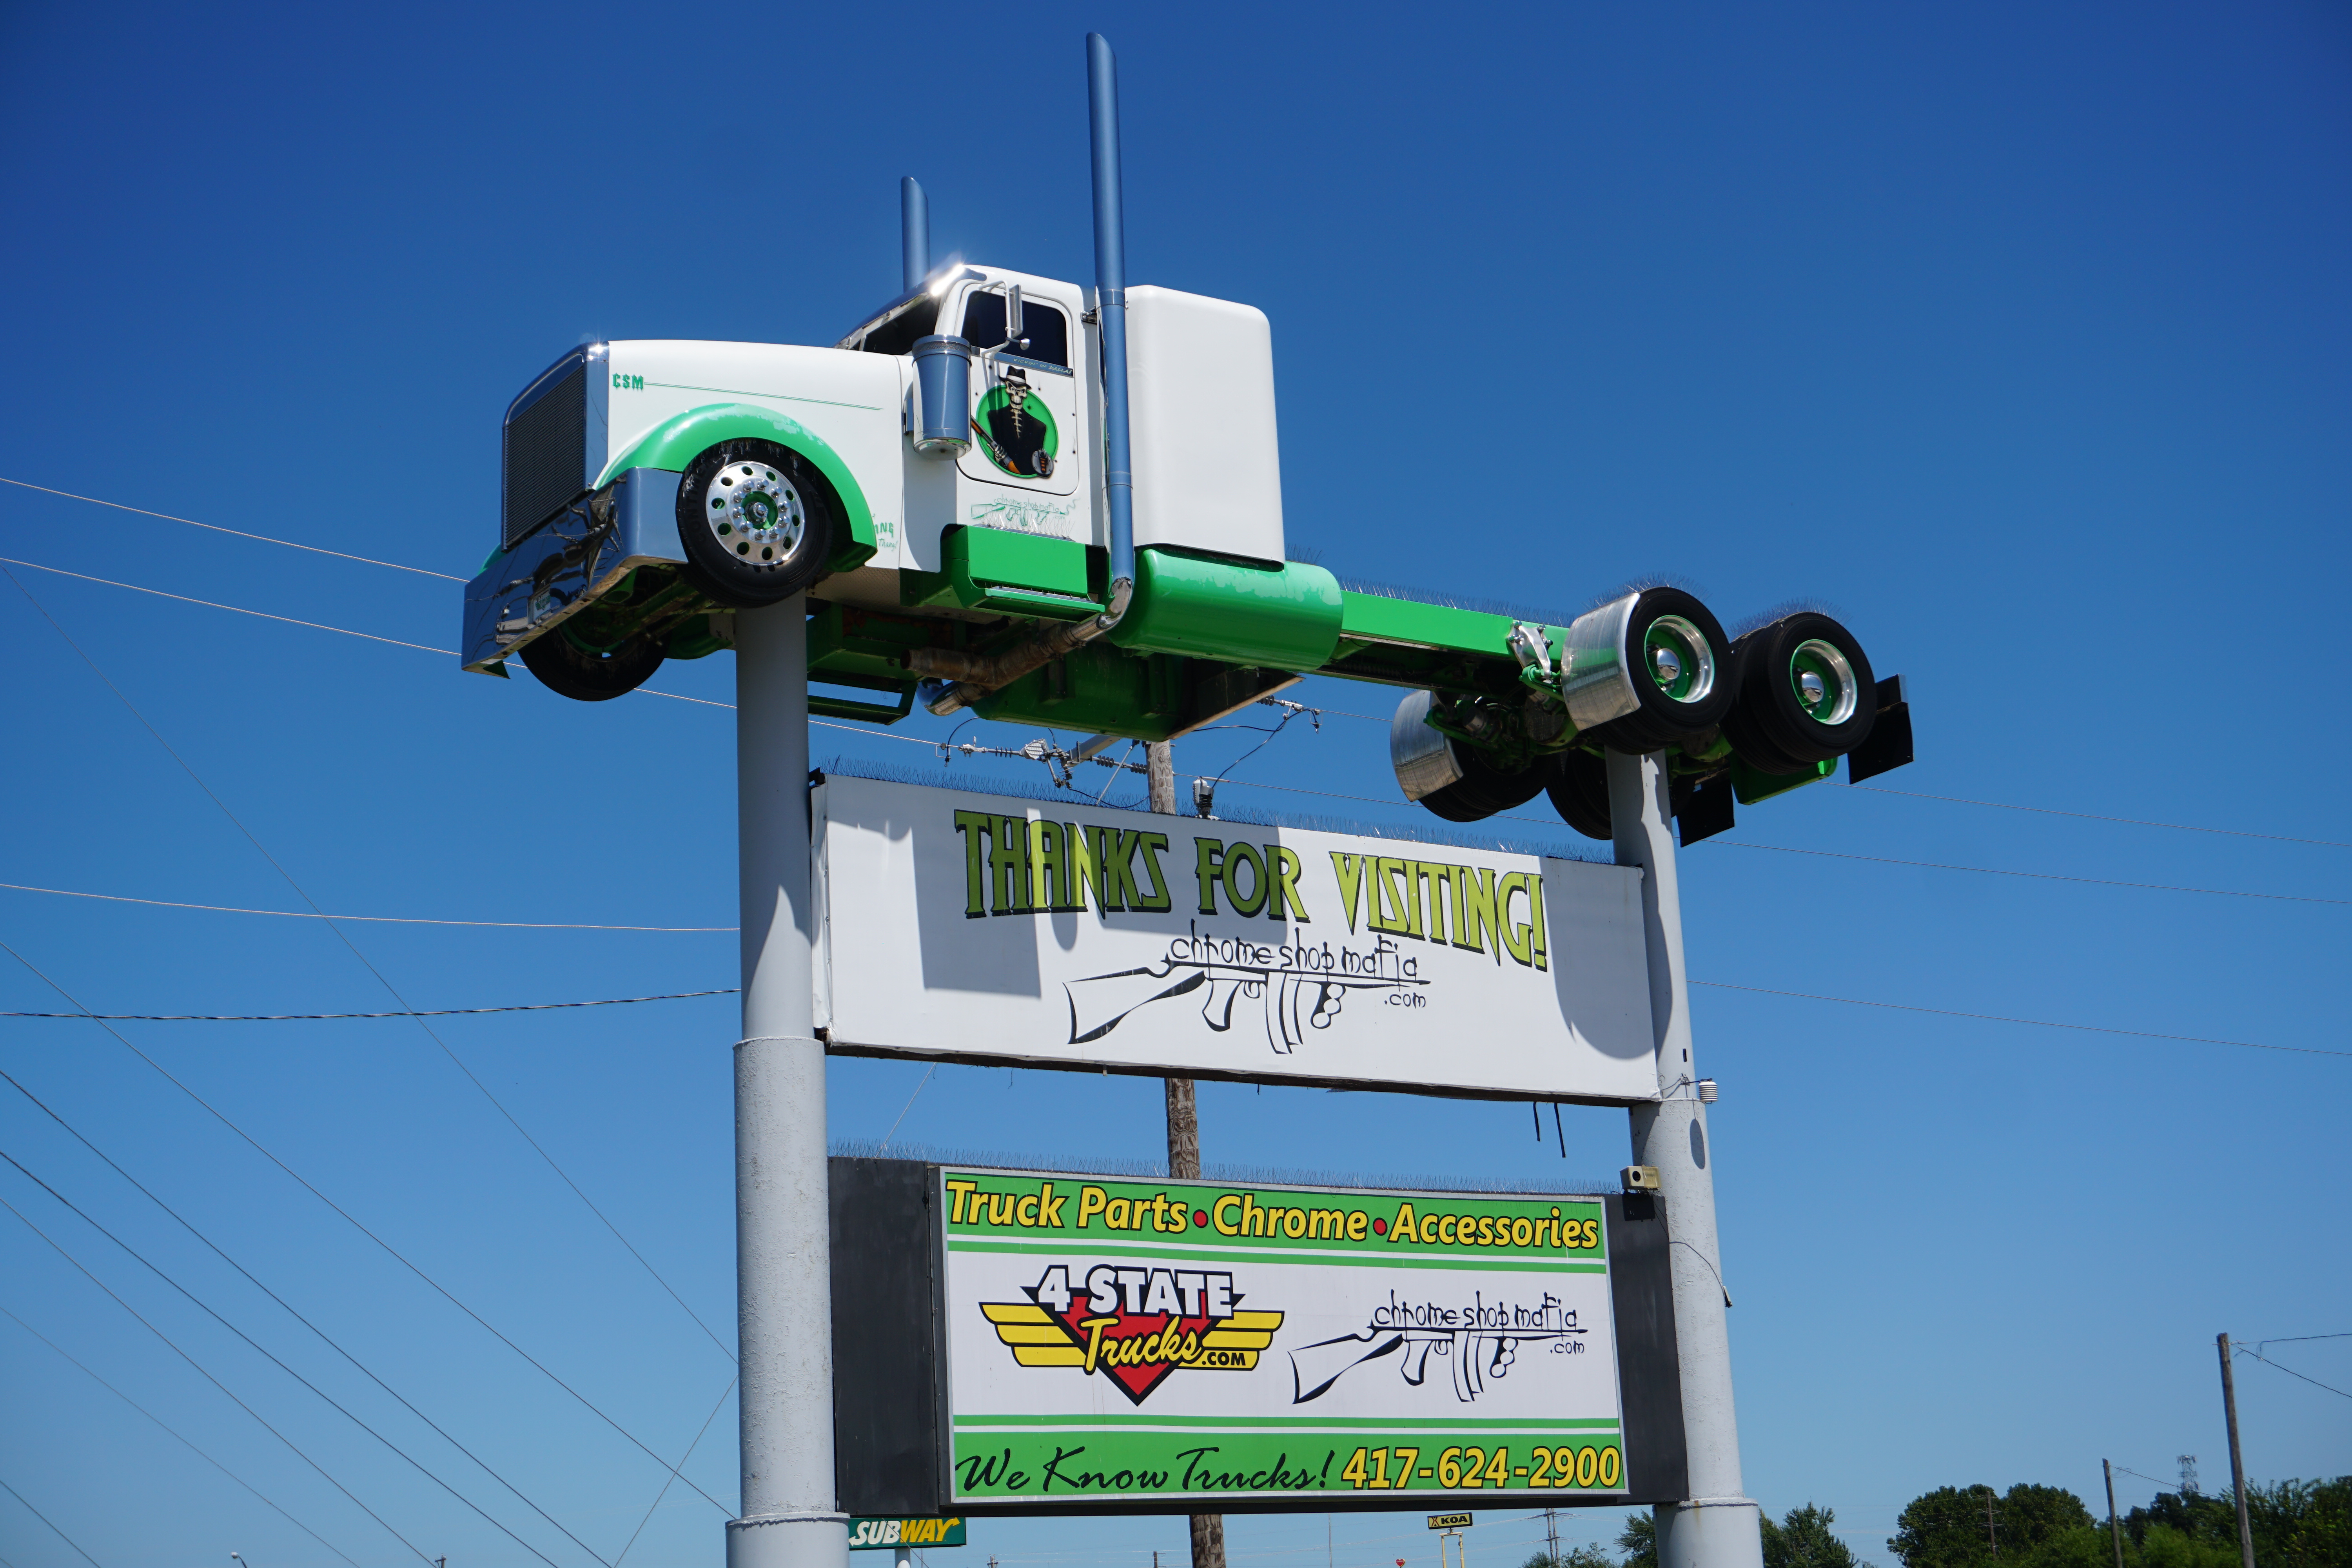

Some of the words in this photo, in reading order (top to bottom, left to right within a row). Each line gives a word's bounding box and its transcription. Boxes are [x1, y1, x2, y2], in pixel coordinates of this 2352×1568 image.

[1049, 365, 1072, 374] DALLAS
[612, 373, 643, 390] CSM
[954, 809, 1171, 920] THANKS
[1194, 837, 1311, 923] FOR
[1328, 851, 1547, 972] VISITING!
[1385, 992, 1426, 1009] .com
[946, 1179, 1069, 1228] Truck
[1076, 1185, 1188, 1234] Parts
[1212, 1193, 1368, 1242] Chrome
[1387, 1202, 1599, 1249] Accessories
[1036, 1265, 1071, 1314] 4
[1085, 1264, 1233, 1319] STATE
[1550, 1341, 1584, 1355] .com
[955, 1448, 1030, 1492] We
[1042, 1446, 1168, 1492] Know
[1176, 1447, 1335, 1490] Trucks!
[1341, 1445, 1621, 1490] 417-624-2900
[849, 1517, 960, 1546] SUBWAY
[1441, 1516, 1468, 1524] KOA
